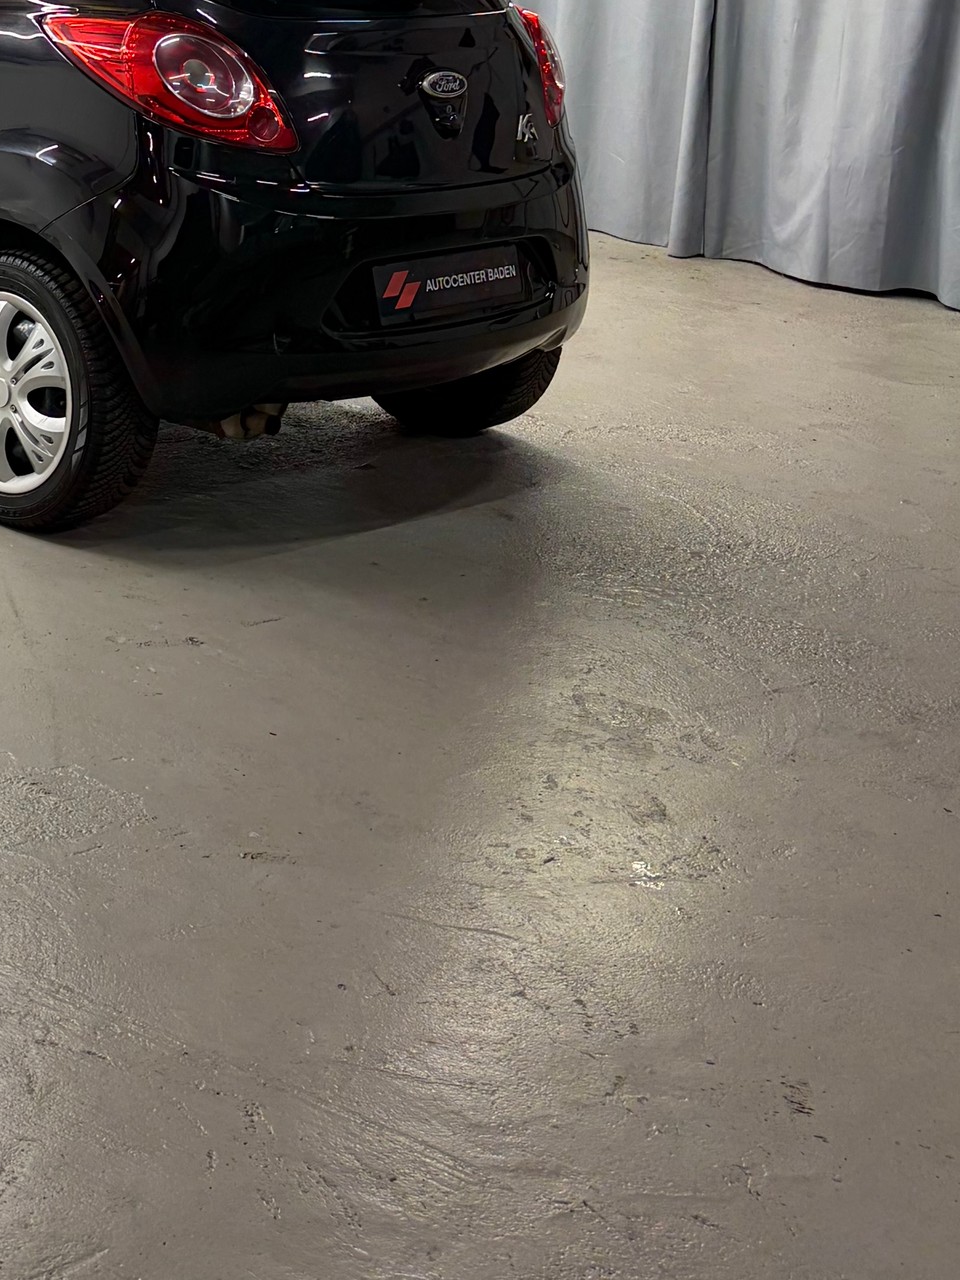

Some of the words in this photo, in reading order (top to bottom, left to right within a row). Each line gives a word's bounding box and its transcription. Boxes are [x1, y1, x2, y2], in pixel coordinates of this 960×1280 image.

[435, 75, 461, 92] Ford
[425, 270, 487, 292] AUTOCENTER
[488, 264, 517, 281] BADEN
